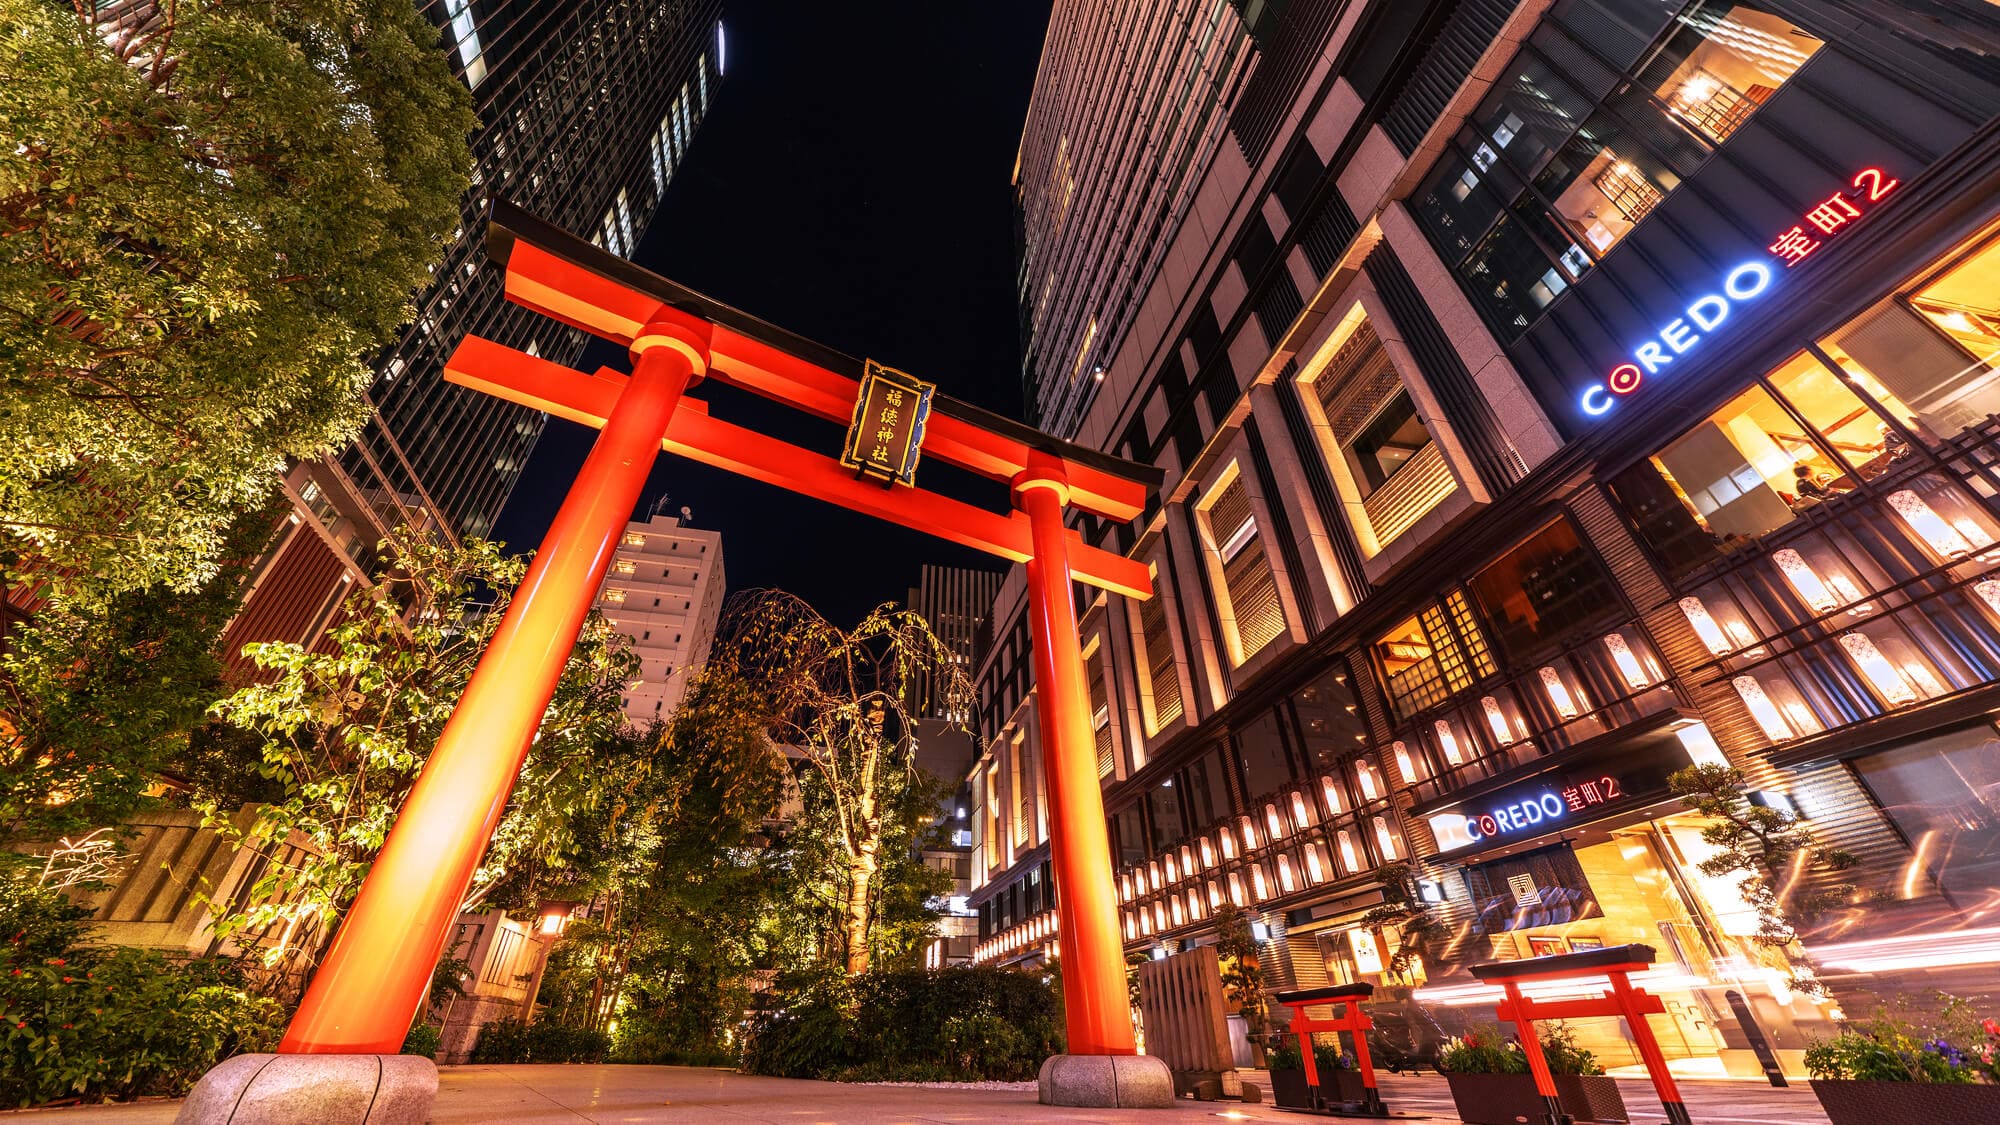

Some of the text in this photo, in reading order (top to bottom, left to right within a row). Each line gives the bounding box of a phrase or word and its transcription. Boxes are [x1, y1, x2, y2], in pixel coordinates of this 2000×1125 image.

[1581, 168, 1897, 415] COREDO 室町2
[872, 389, 902, 462] 福徳神社
[1465, 777, 1619, 840] COREDO 室町2
